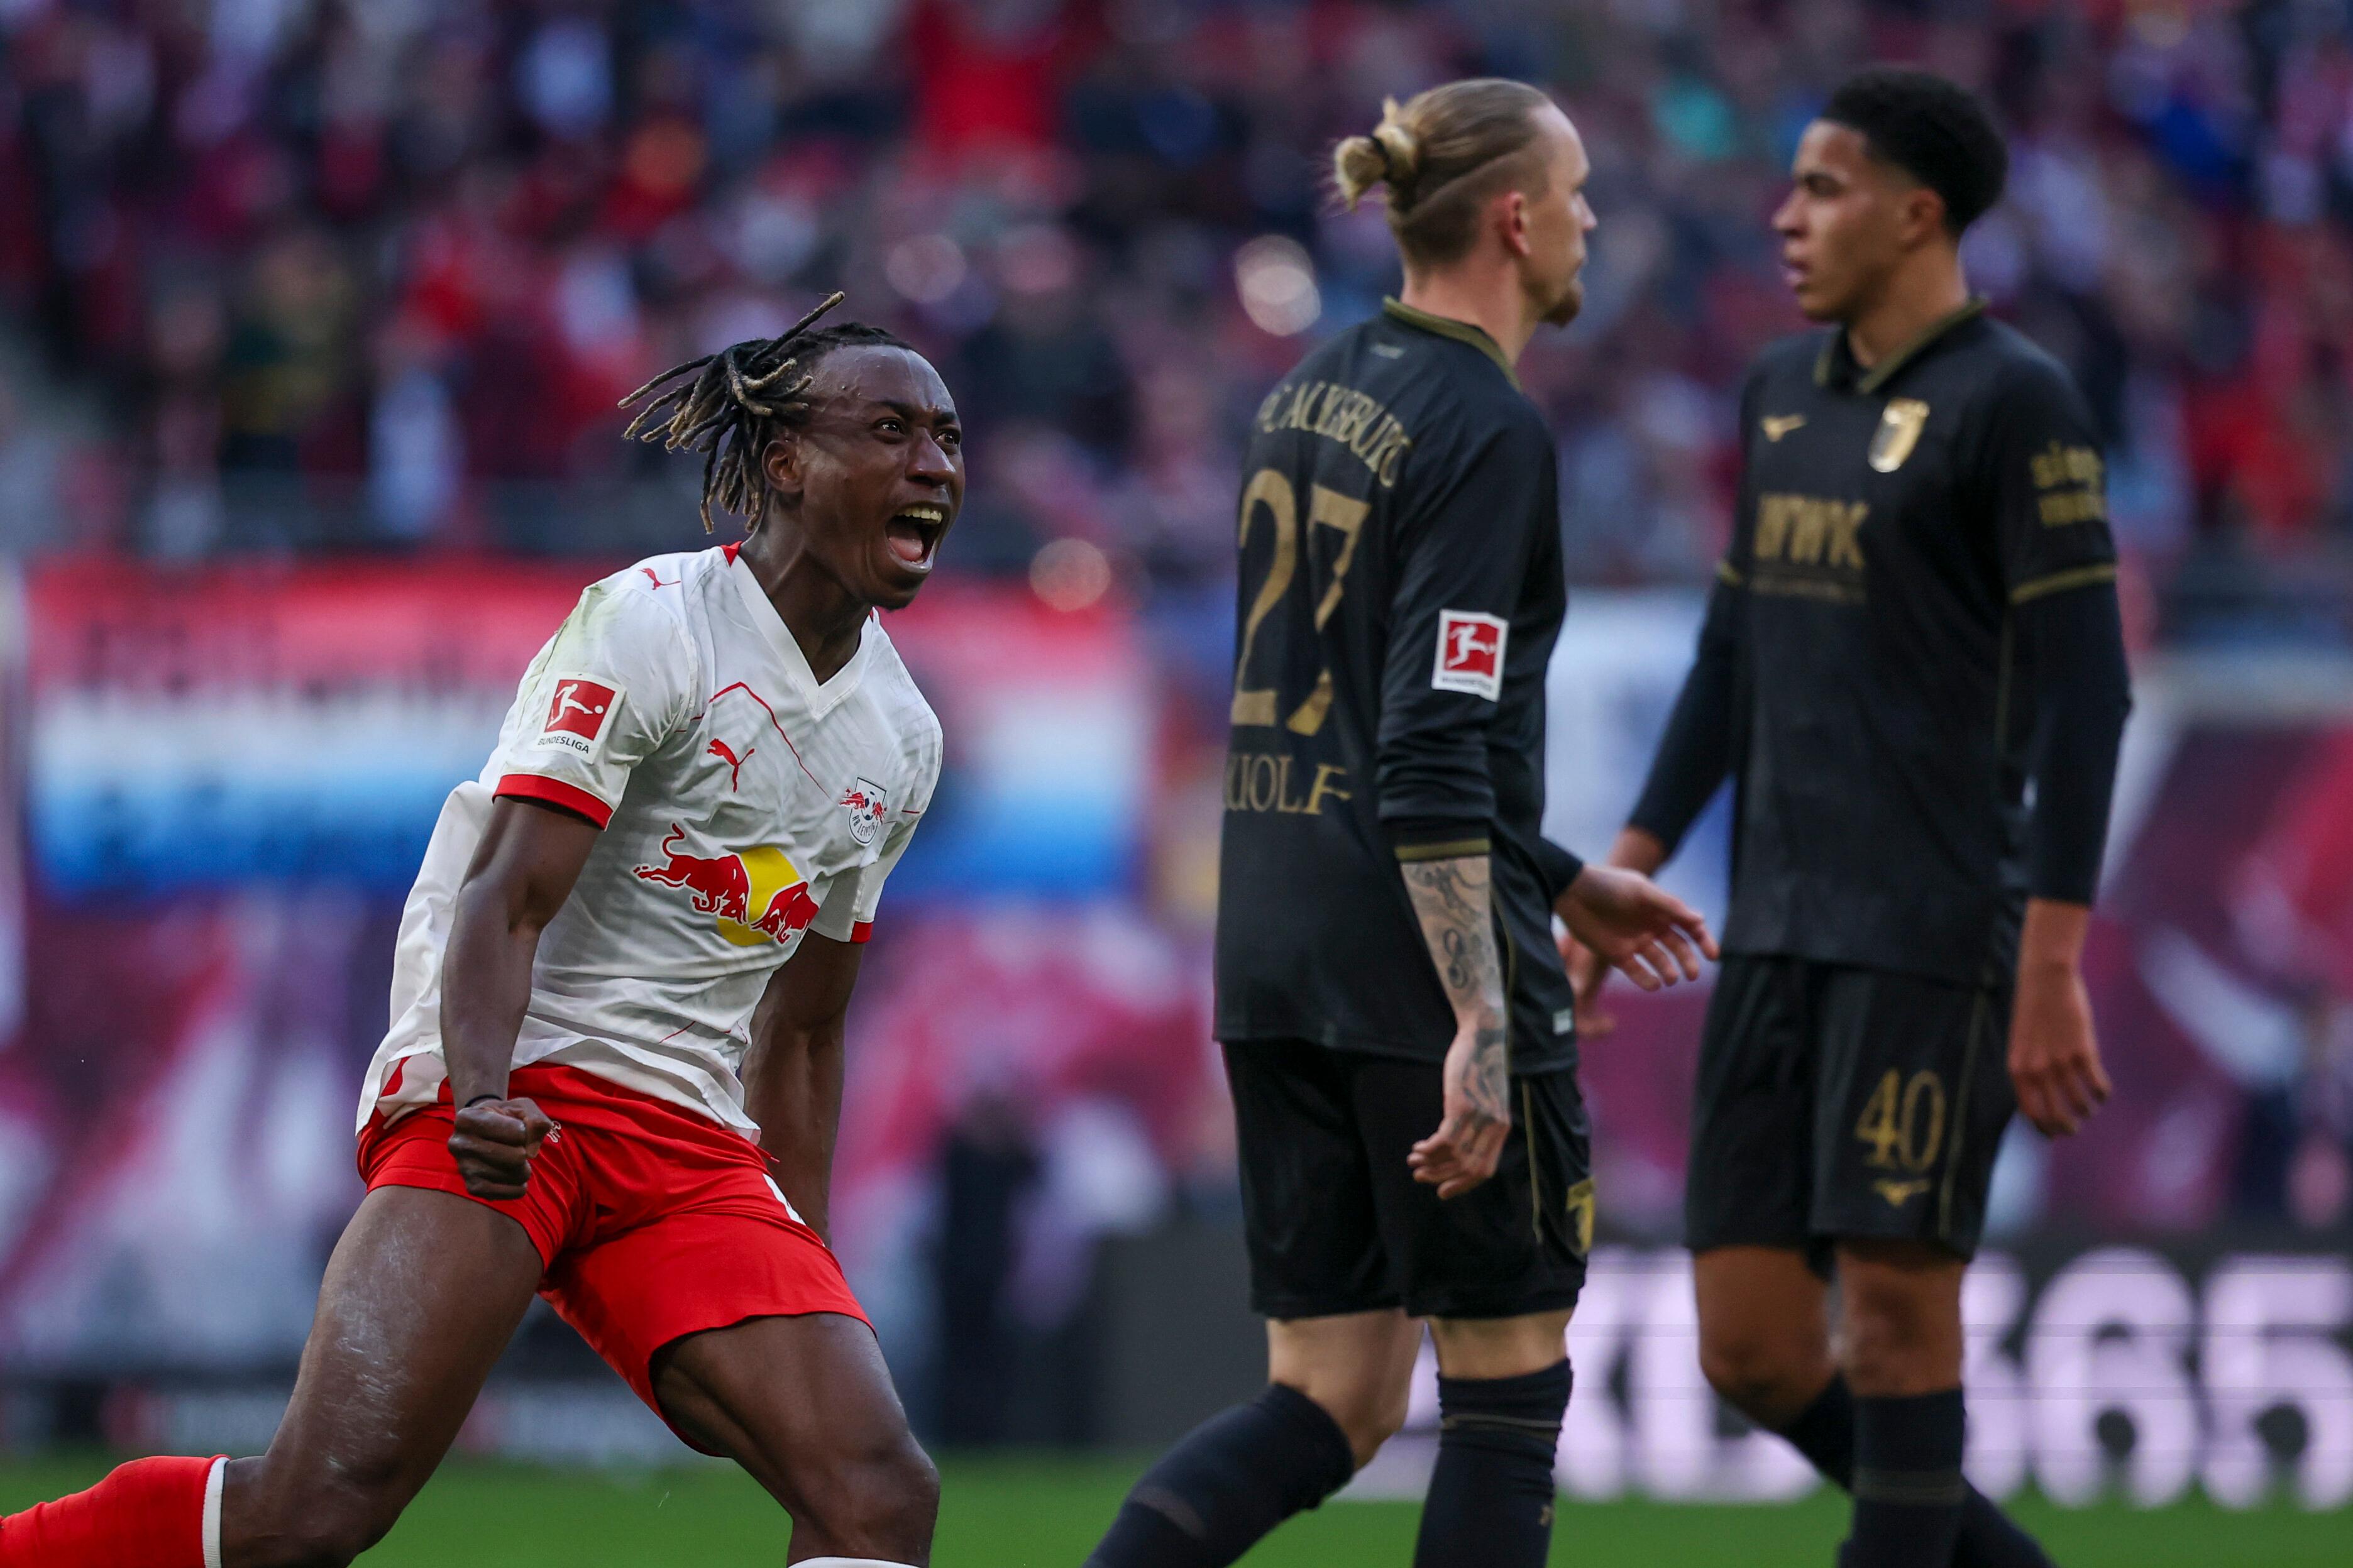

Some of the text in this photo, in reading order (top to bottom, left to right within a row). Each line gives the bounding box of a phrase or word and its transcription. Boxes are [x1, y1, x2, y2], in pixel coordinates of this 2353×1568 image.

[1230, 468, 1372, 737] 27
[537, 736, 590, 754] BUNDESLIGA
[1855, 1068, 1947, 1171] 40
